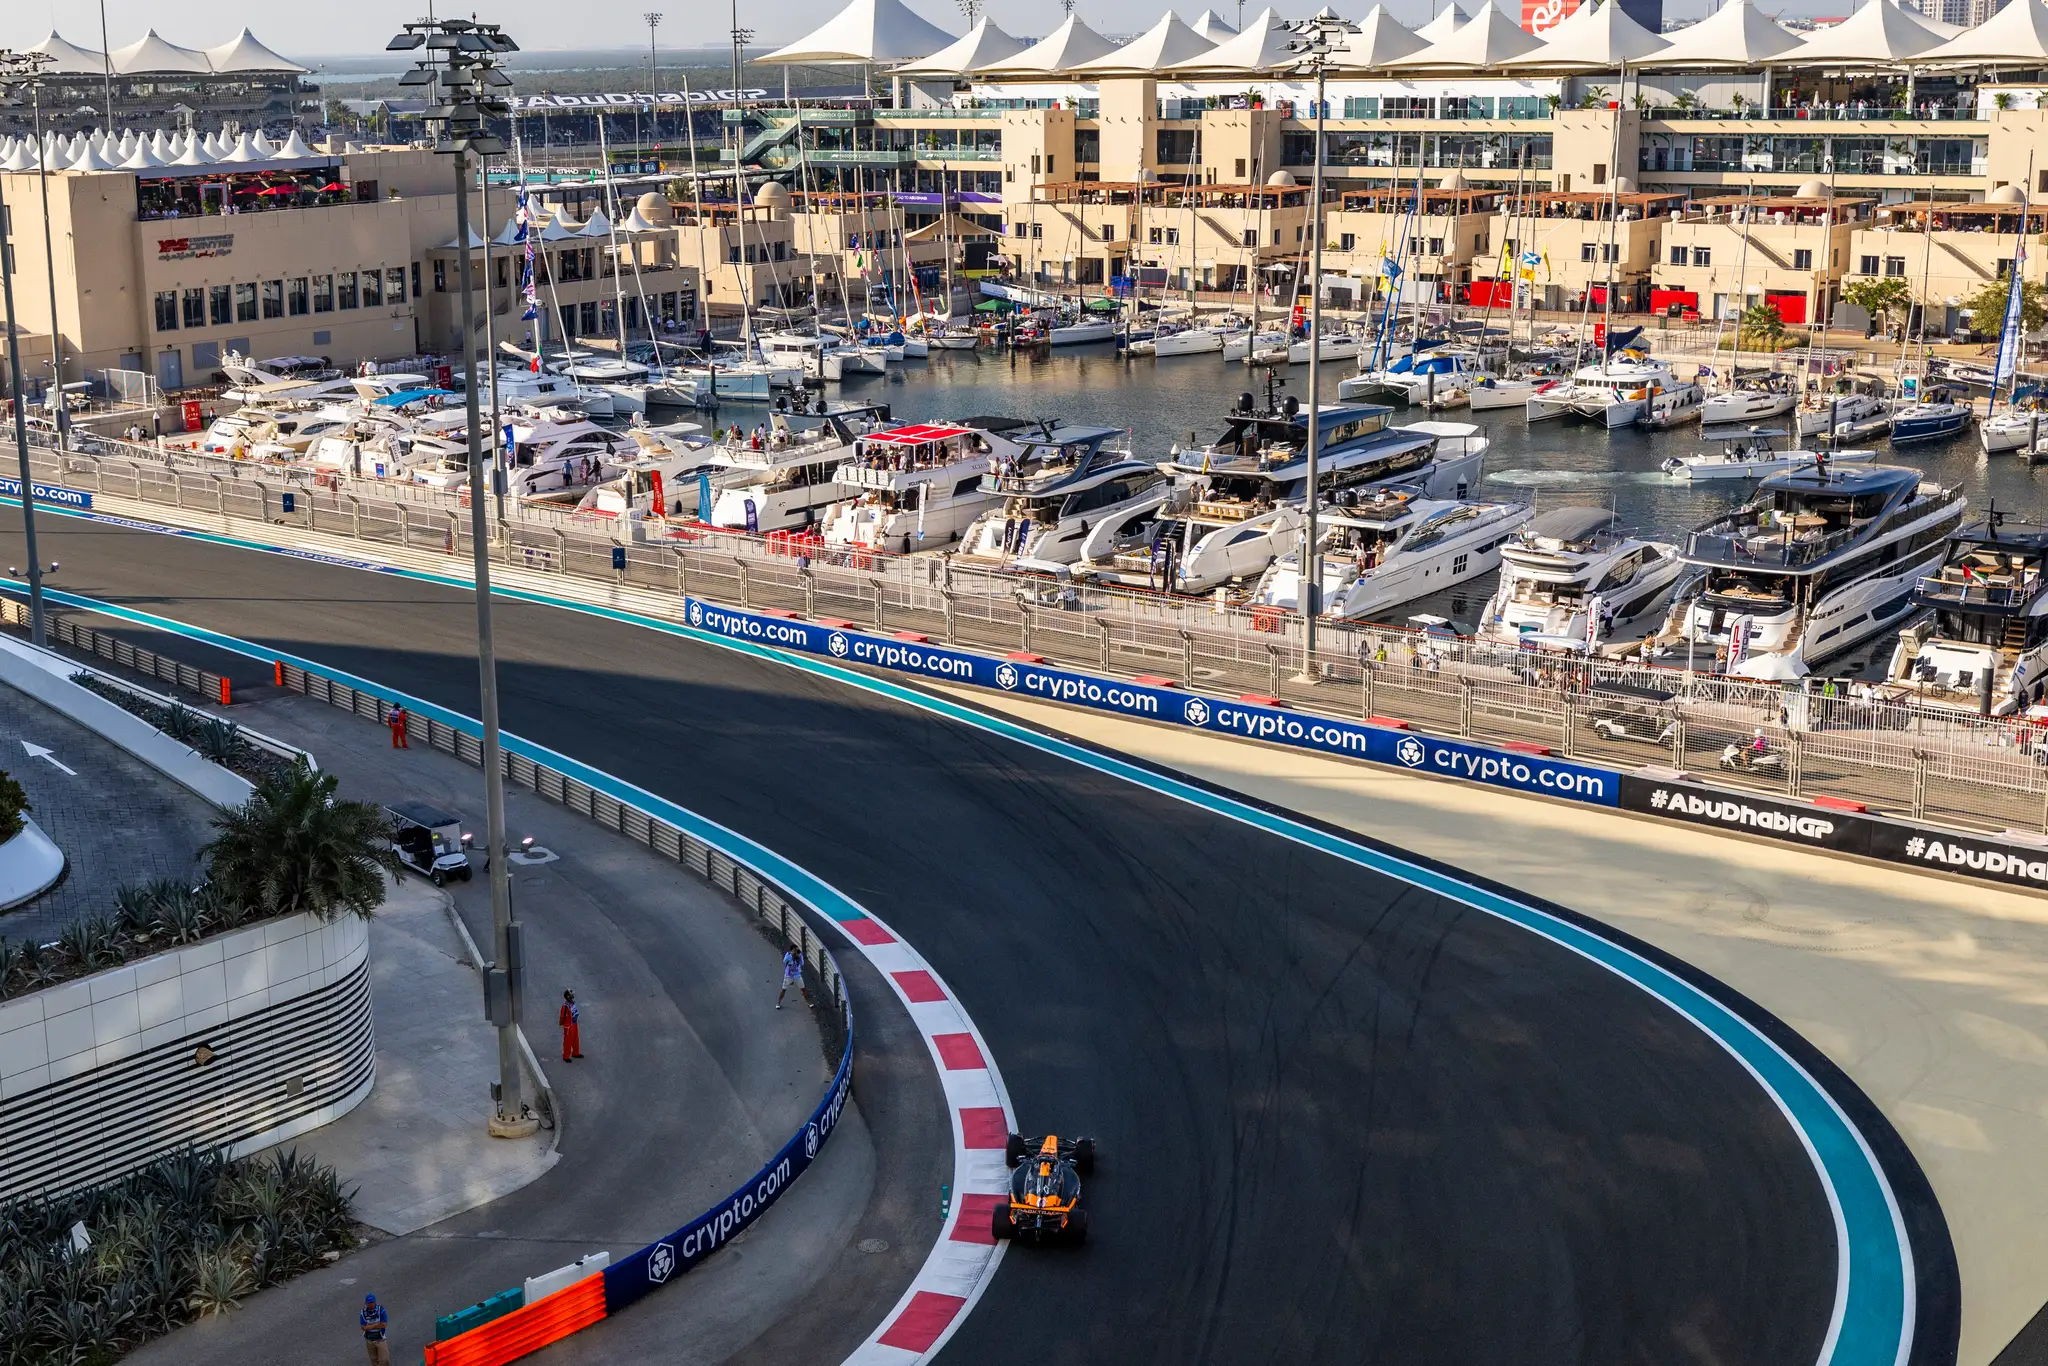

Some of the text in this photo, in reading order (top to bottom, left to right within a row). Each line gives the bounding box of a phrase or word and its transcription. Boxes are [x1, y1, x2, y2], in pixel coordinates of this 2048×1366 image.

[500, 88, 768, 108] #AbuDhabiGP
[614, 165, 625, 174] FIA
[645, 164, 656, 172] FIA
[157, 237, 189, 253] YAS
[0, 480, 82, 504] cryto.com
[706, 610, 807, 646] crypto.com
[1731, 625, 1740, 664] VIP
[854, 641, 973, 679] crypto.com
[1025, 672, 1158, 713] crypto.com
[1218, 709, 1367, 753] crypto.com
[1434, 749, 1604, 797] crypto.com
[1650, 789, 1834, 839] #AbuDhabiGP
[683, 1157, 790, 1258] crypto.com
